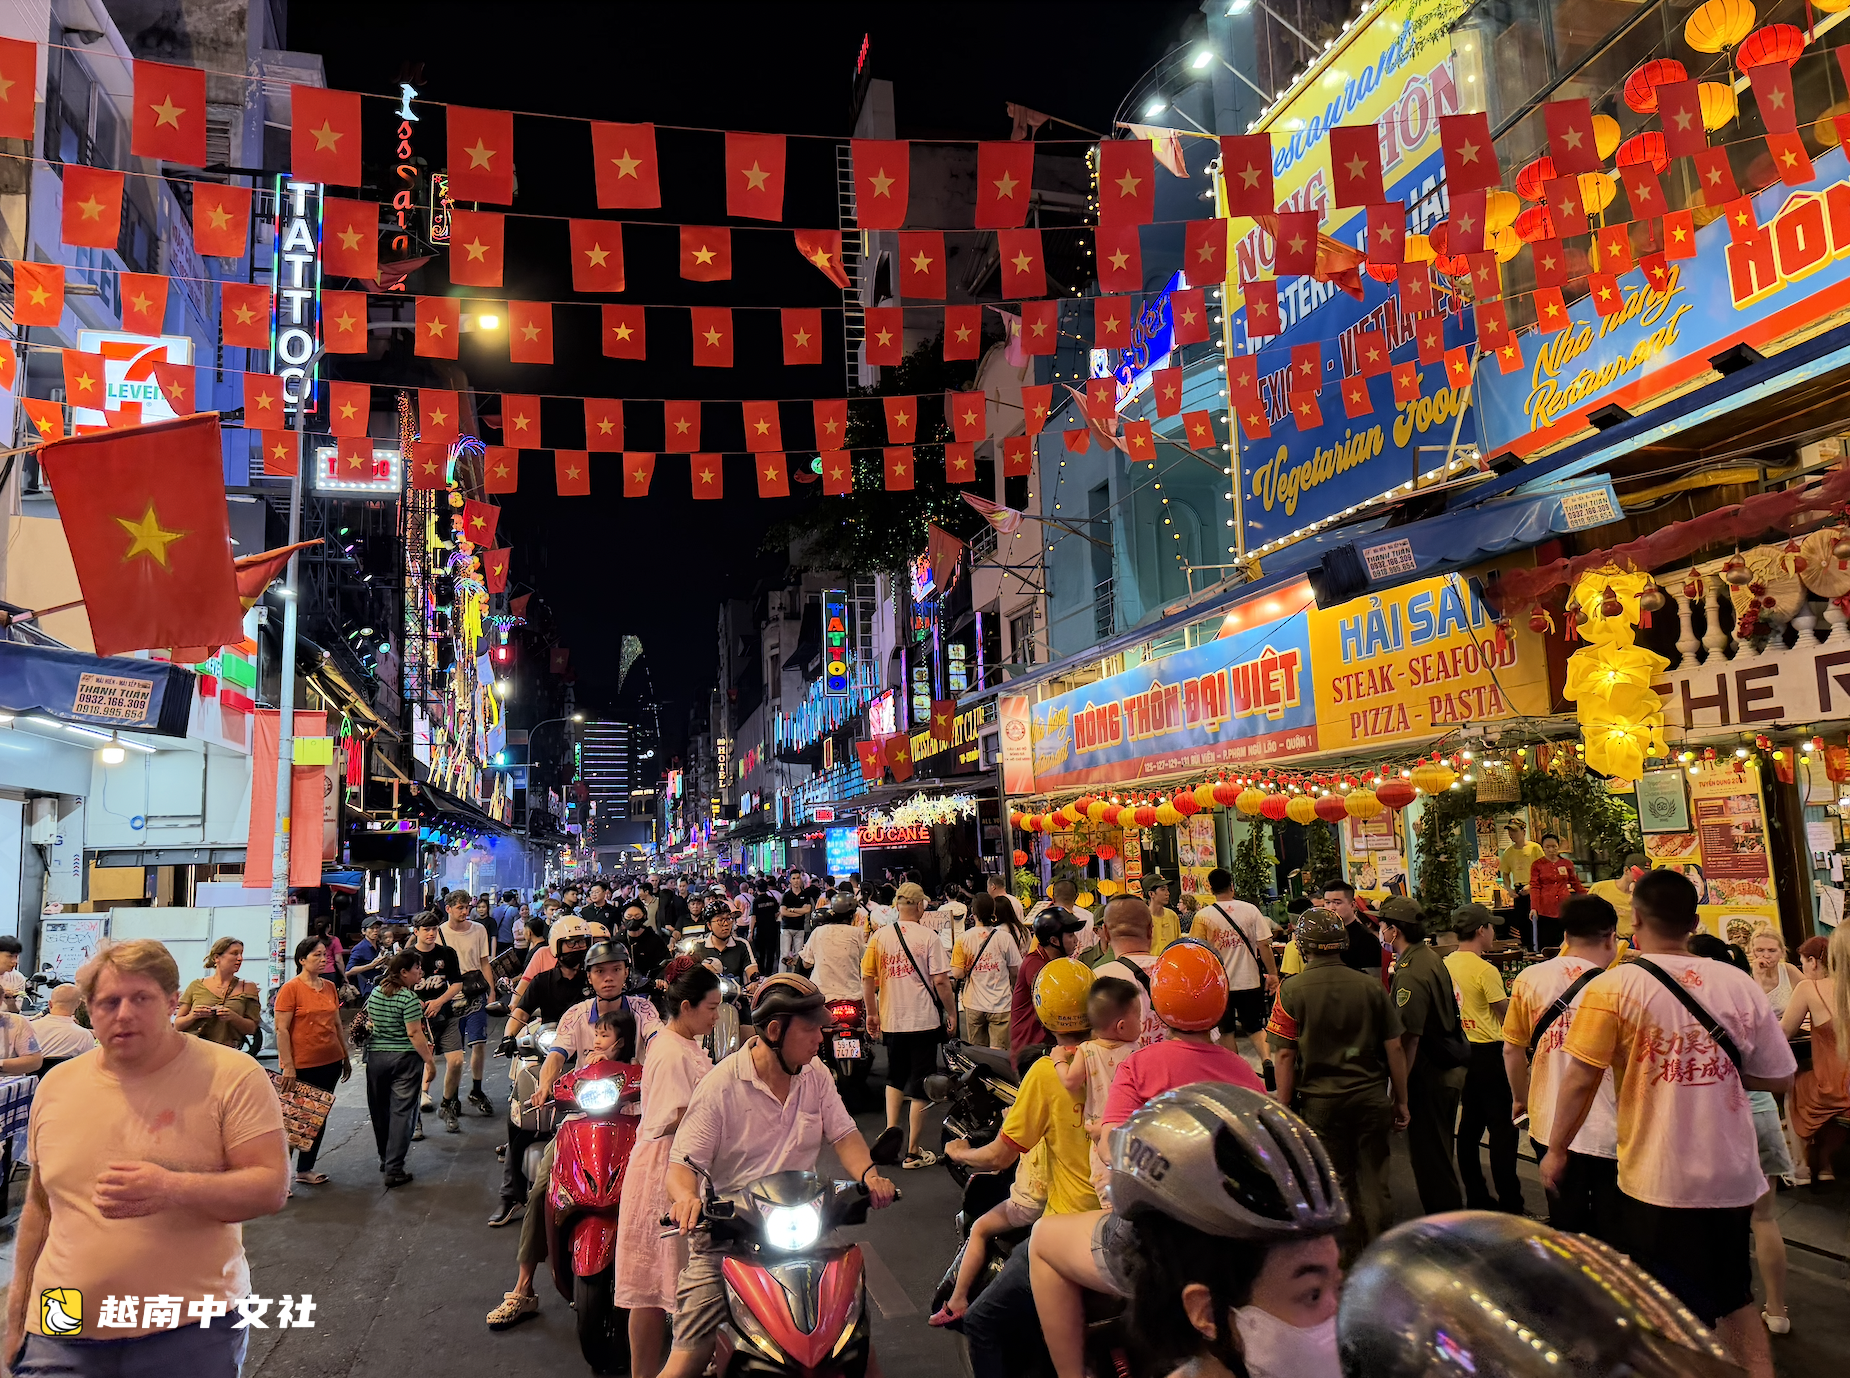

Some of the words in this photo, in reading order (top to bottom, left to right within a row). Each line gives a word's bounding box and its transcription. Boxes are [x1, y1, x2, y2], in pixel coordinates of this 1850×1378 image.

[279, 183, 315, 404] TATTOO
[1524, 304, 1693, 432] Restaurant
[1532, 319, 1594, 390] Nhà
[1252, 425, 1384, 516] Vegetarian
[827, 602, 847, 691] TATTOO
[1339, 596, 1402, 663] HẢI
[79, 684, 117, 696] THANH
[79, 693, 146, 710] 0932.166.309
[1073, 701, 1121, 752] NÔNG
[1122, 679, 1182, 740] THÔN
[1182, 671, 1229, 729] ĐẠI
[1230, 645, 1301, 718] VIỆT
[1332, 663, 1396, 704] STEAK
[1408, 639, 1518, 688] SEAFOOD
[76, 703, 143, 719] 0918.995.654
[1307, 735, 1313, 747] 1
[1350, 702, 1411, 740] PIZZA
[1429, 683, 1506, 724] PASTA
